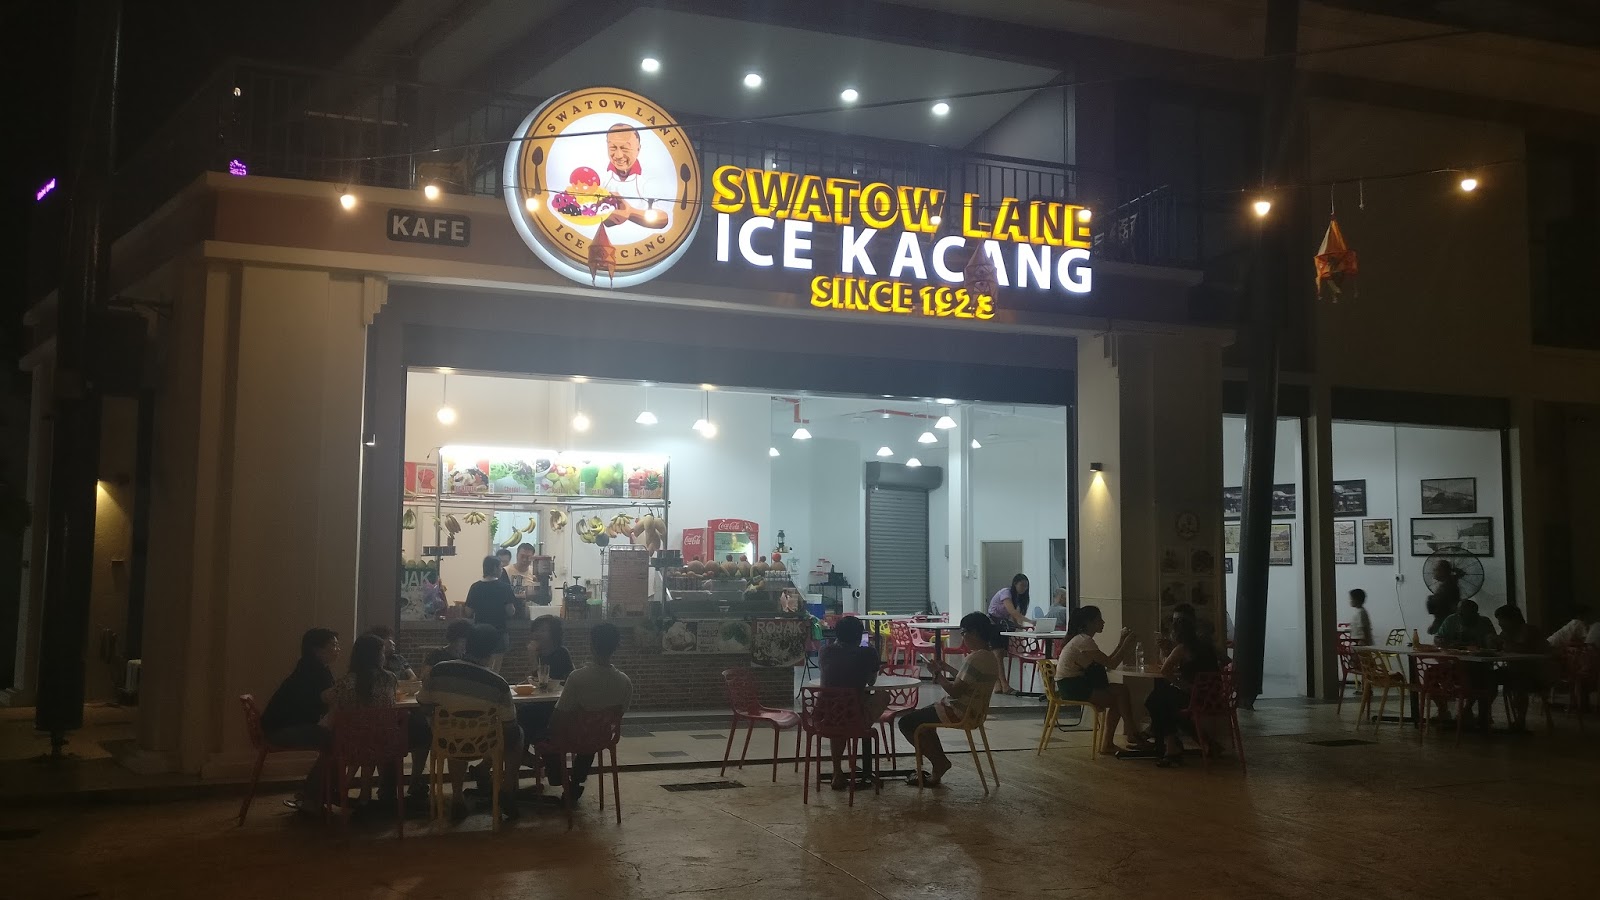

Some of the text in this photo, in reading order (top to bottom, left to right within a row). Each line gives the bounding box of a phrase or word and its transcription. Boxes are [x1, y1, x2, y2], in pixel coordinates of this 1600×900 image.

[547, 99, 679, 148] SWATOW LANE
[711, 165, 947, 233] SWATOW
[962, 192, 1092, 250] LANE
[392, 215, 464, 241] KAFE
[555, 224, 666, 259] ICE CANG
[716, 212, 813, 270] ICE
[810, 275, 995, 319] SINCE 1923
[401, 570, 431, 589] JAK
[756, 621, 803, 634] ROJAK
